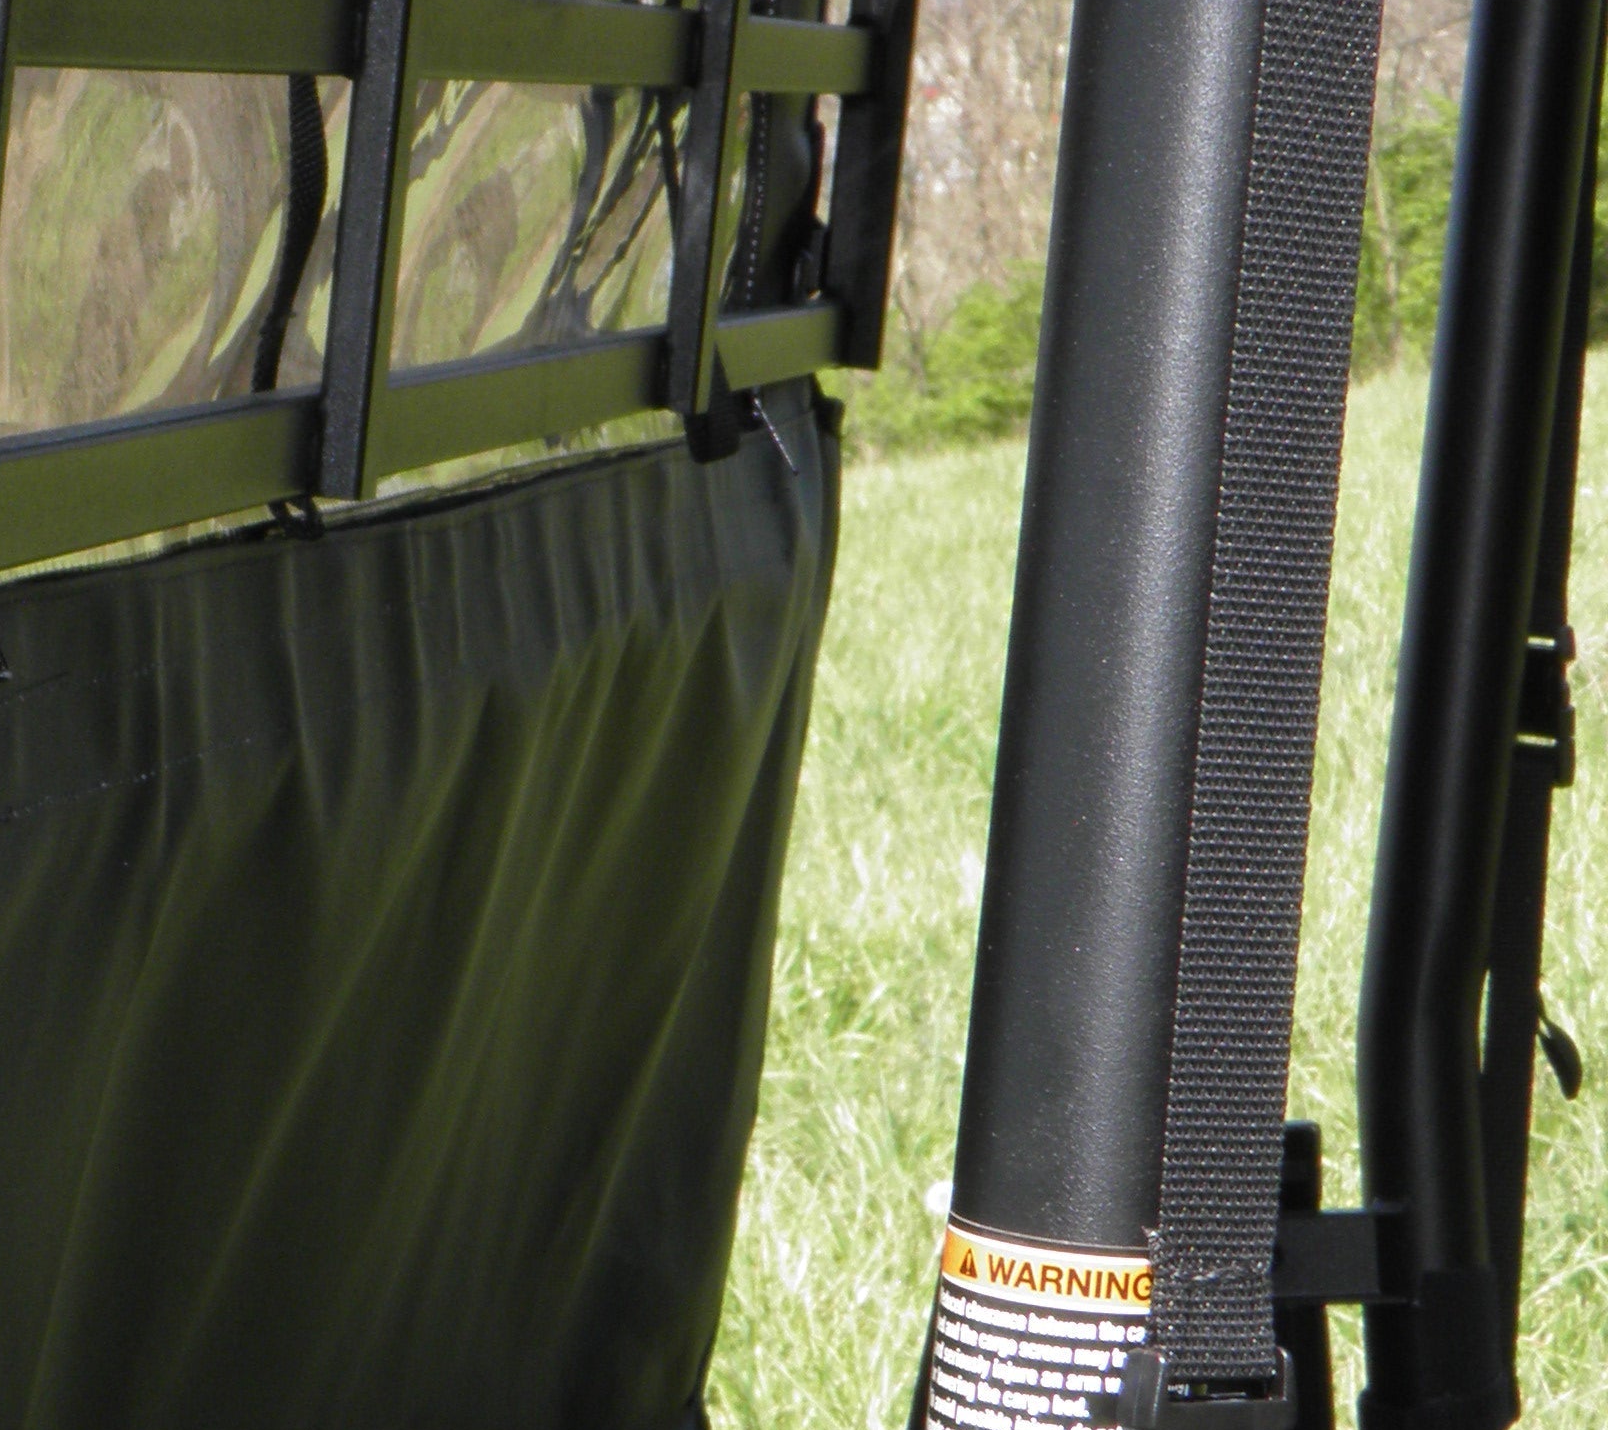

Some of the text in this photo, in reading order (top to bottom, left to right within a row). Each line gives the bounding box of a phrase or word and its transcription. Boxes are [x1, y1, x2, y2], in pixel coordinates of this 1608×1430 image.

[988, 1254, 1153, 1302] WARNING
[966, 1300, 1027, 1332] clearance
[1028, 1312, 1097, 1341] between
[1098, 1321, 1125, 1343] the
[944, 1347, 991, 1380] seriously
[992, 1358, 1039, 1386] injure
[1040, 1371, 1064, 1390] an
[1066, 1373, 1102, 1393] arm
[960, 1323, 978, 1348] the
[978, 1332, 1018, 1359] cargo
[1018, 1340, 1072, 1365] screen
[1073, 1349, 1110, 1371] may
[977, 1381, 1001, 1406] the
[1002, 1391, 1050, 1416] cargo
[1052, 1394, 1090, 1418] bed.
